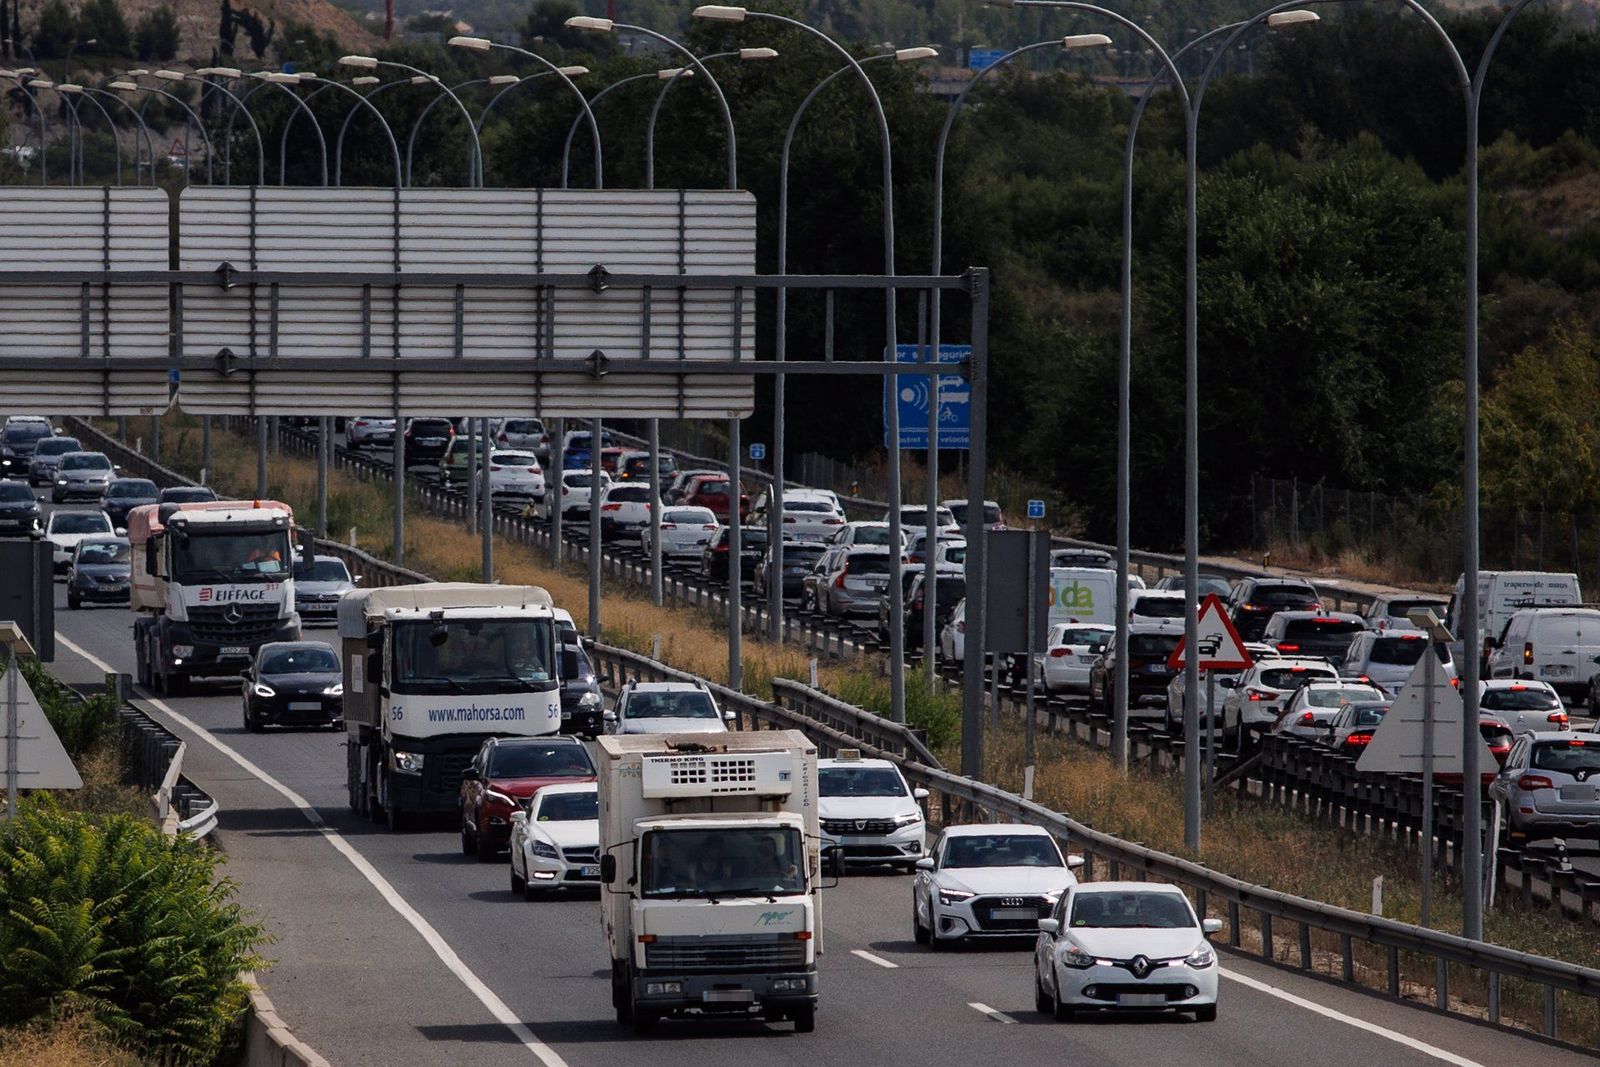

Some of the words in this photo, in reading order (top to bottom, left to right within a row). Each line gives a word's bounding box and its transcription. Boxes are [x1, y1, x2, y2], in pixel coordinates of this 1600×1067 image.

[265, 583, 280, 593] 317
[215, 589, 266, 601] EIFFAGE
[392, 706, 404, 721] 56
[428, 703, 525, 722] www.mahorsa.com
[547, 703, 559, 719] 56
